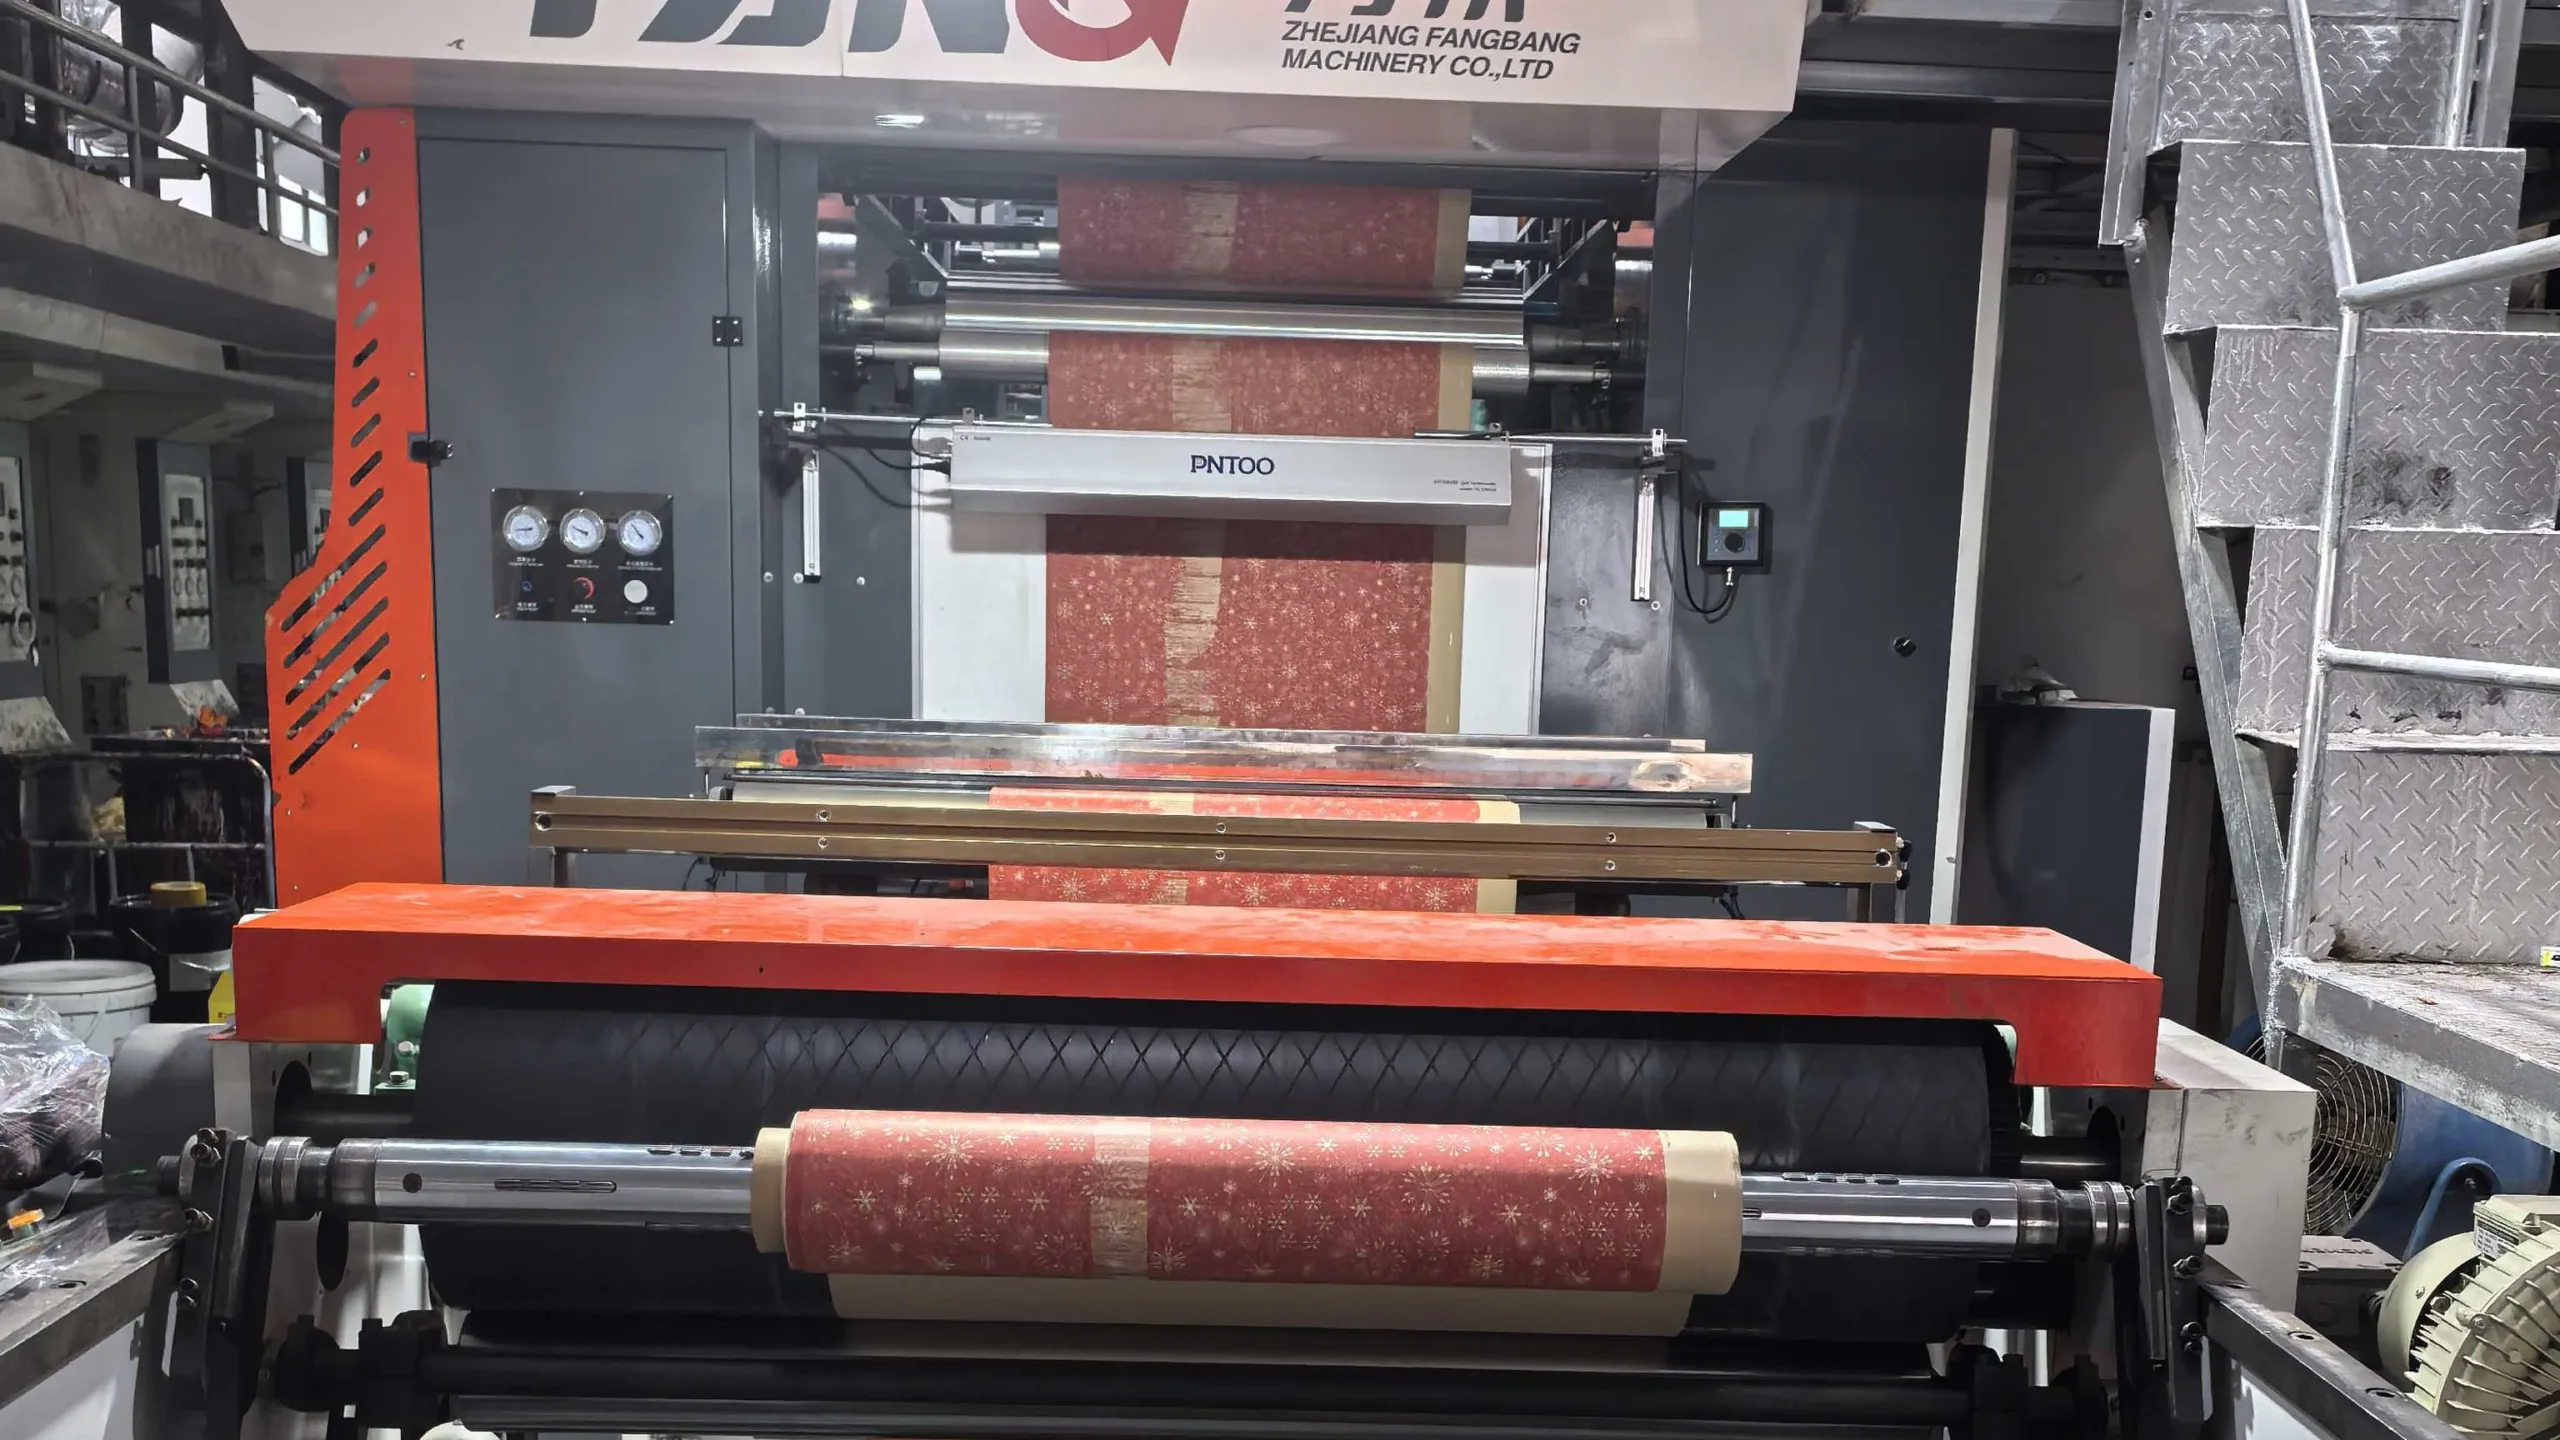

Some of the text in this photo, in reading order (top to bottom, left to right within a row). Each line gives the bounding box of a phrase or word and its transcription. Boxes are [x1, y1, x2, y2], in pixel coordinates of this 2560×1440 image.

[1281, 20, 1581, 54] ZHEJIANG FANGBANG
[1282, 48, 1554, 81] MACHINERY CO.,LTD
[1190, 454, 1275, 475] PNTOO
